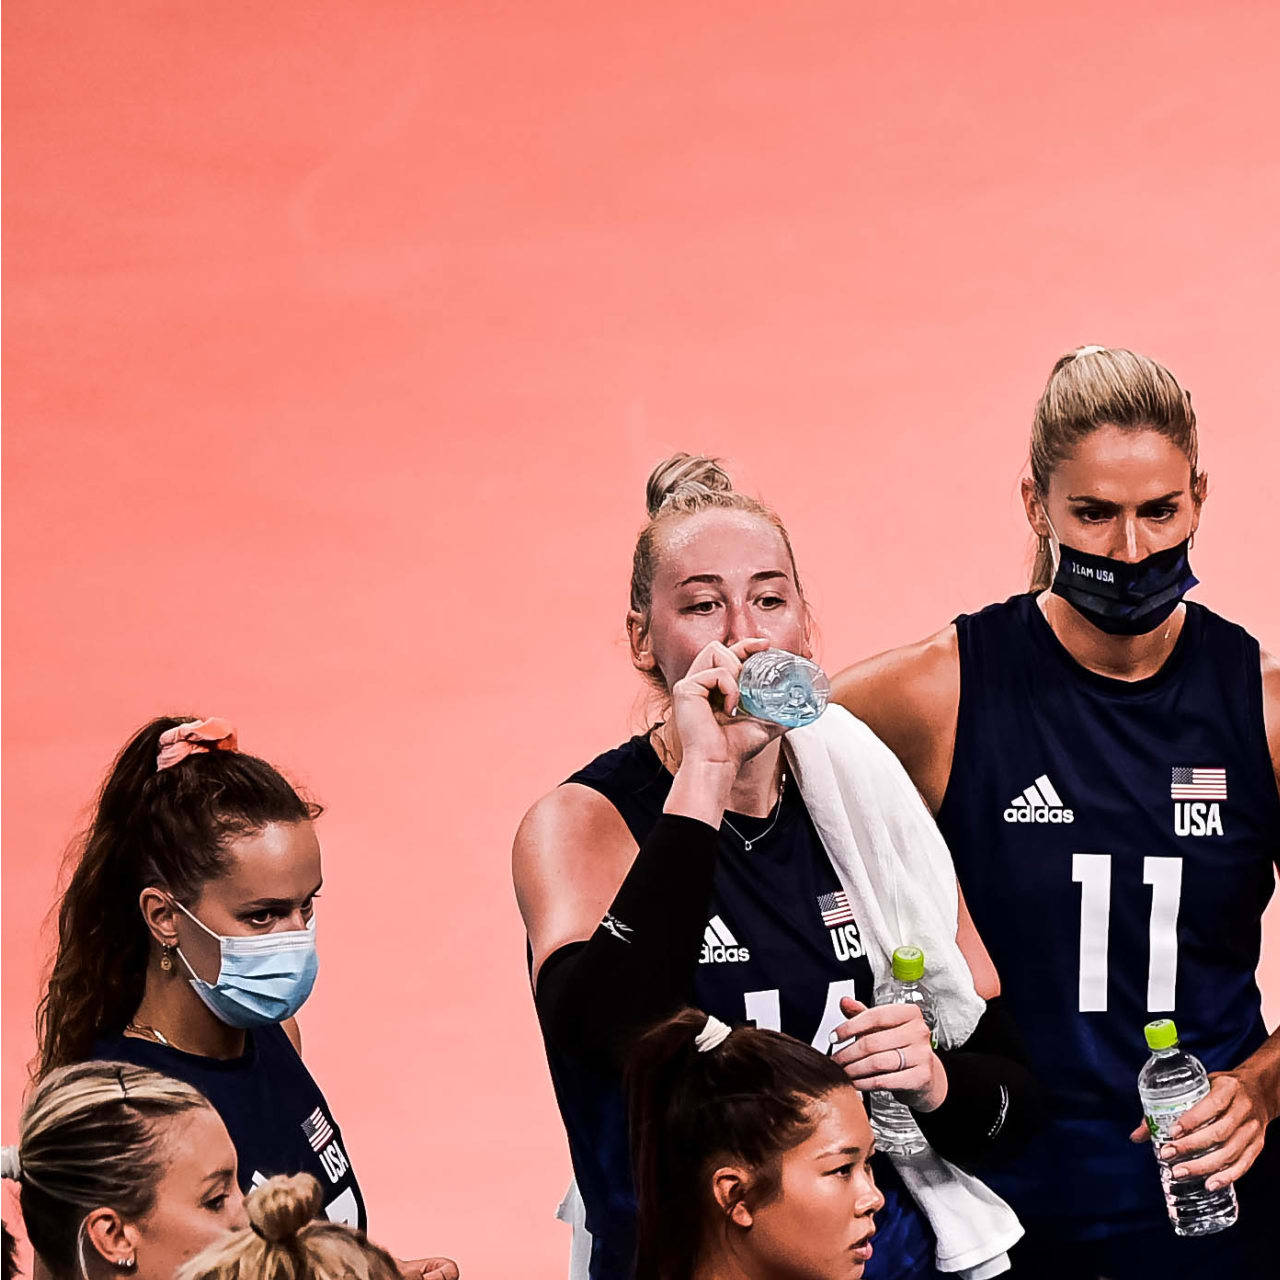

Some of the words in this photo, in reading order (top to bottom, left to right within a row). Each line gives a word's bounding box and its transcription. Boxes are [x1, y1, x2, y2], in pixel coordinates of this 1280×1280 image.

[1072, 561, 1093, 579] TEAM
[1096, 568, 1114, 583] USA
[1004, 803, 1074, 823] adidas
[1174, 803, 1224, 837] USA
[830, 924, 865, 962] US
[1072, 854, 1183, 1012] 11
[699, 944, 750, 964] didas
[319, 1140, 348, 1183] USA
